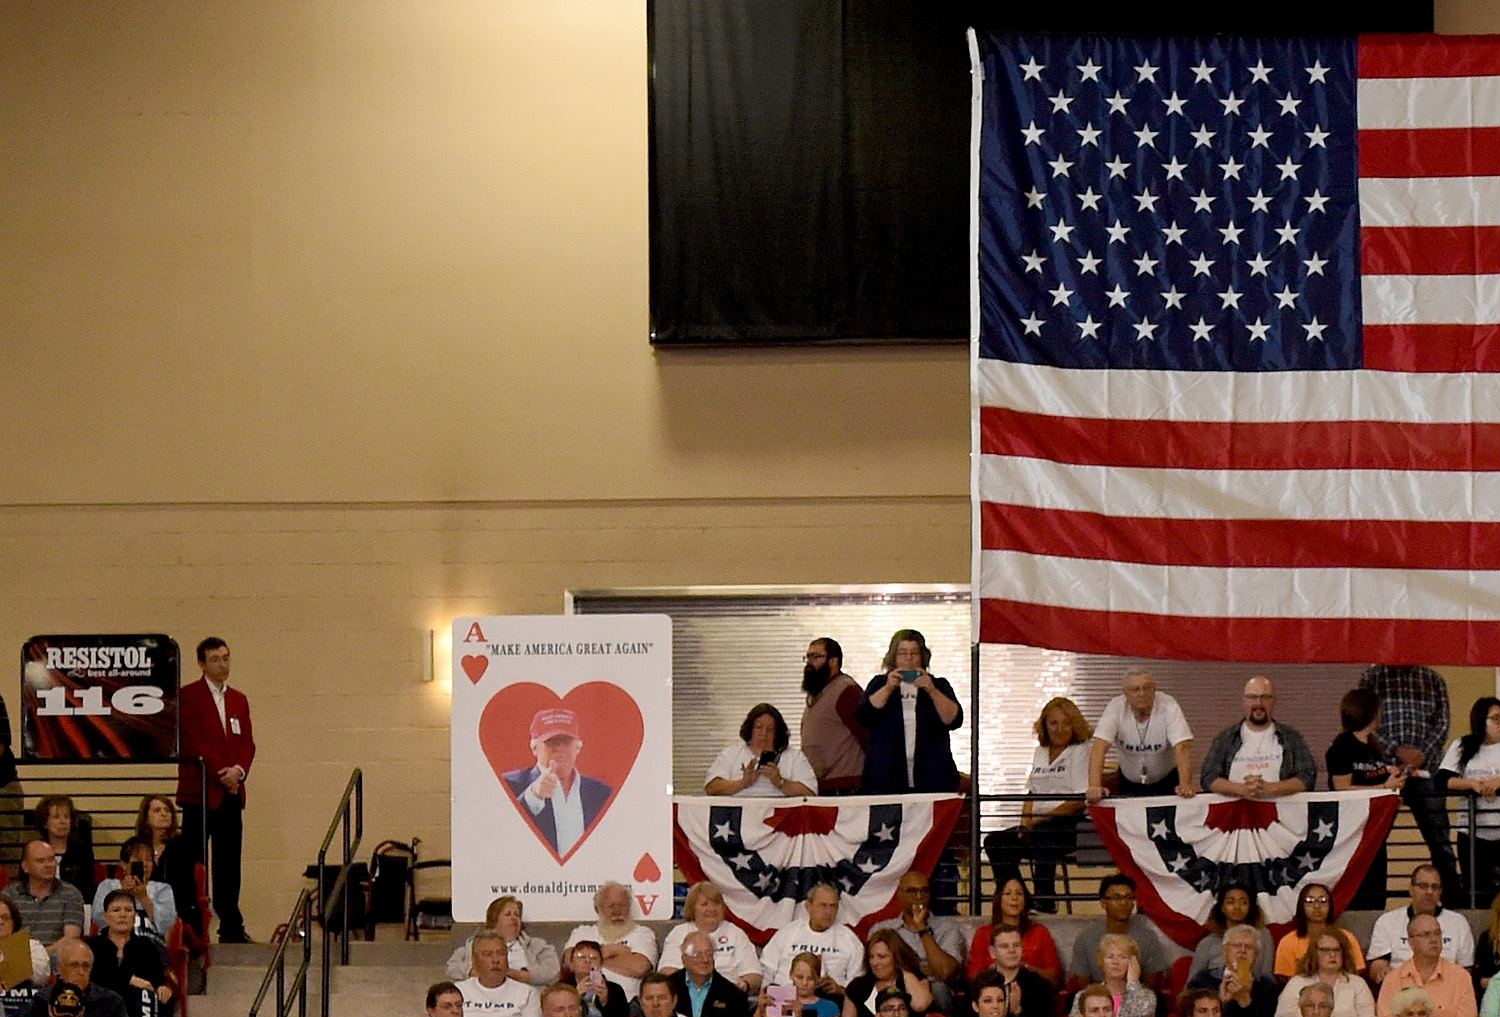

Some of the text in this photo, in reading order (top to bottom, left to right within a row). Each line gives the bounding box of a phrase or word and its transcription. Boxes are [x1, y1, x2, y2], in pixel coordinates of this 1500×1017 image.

[463, 622, 488, 642] A
[46, 647, 151, 669] RESISTOL
[486, 642, 653, 656] "MAKE AMERICA GREAT AGAIN"
[37, 686, 164, 715] 116
[634, 895, 658, 915] A
